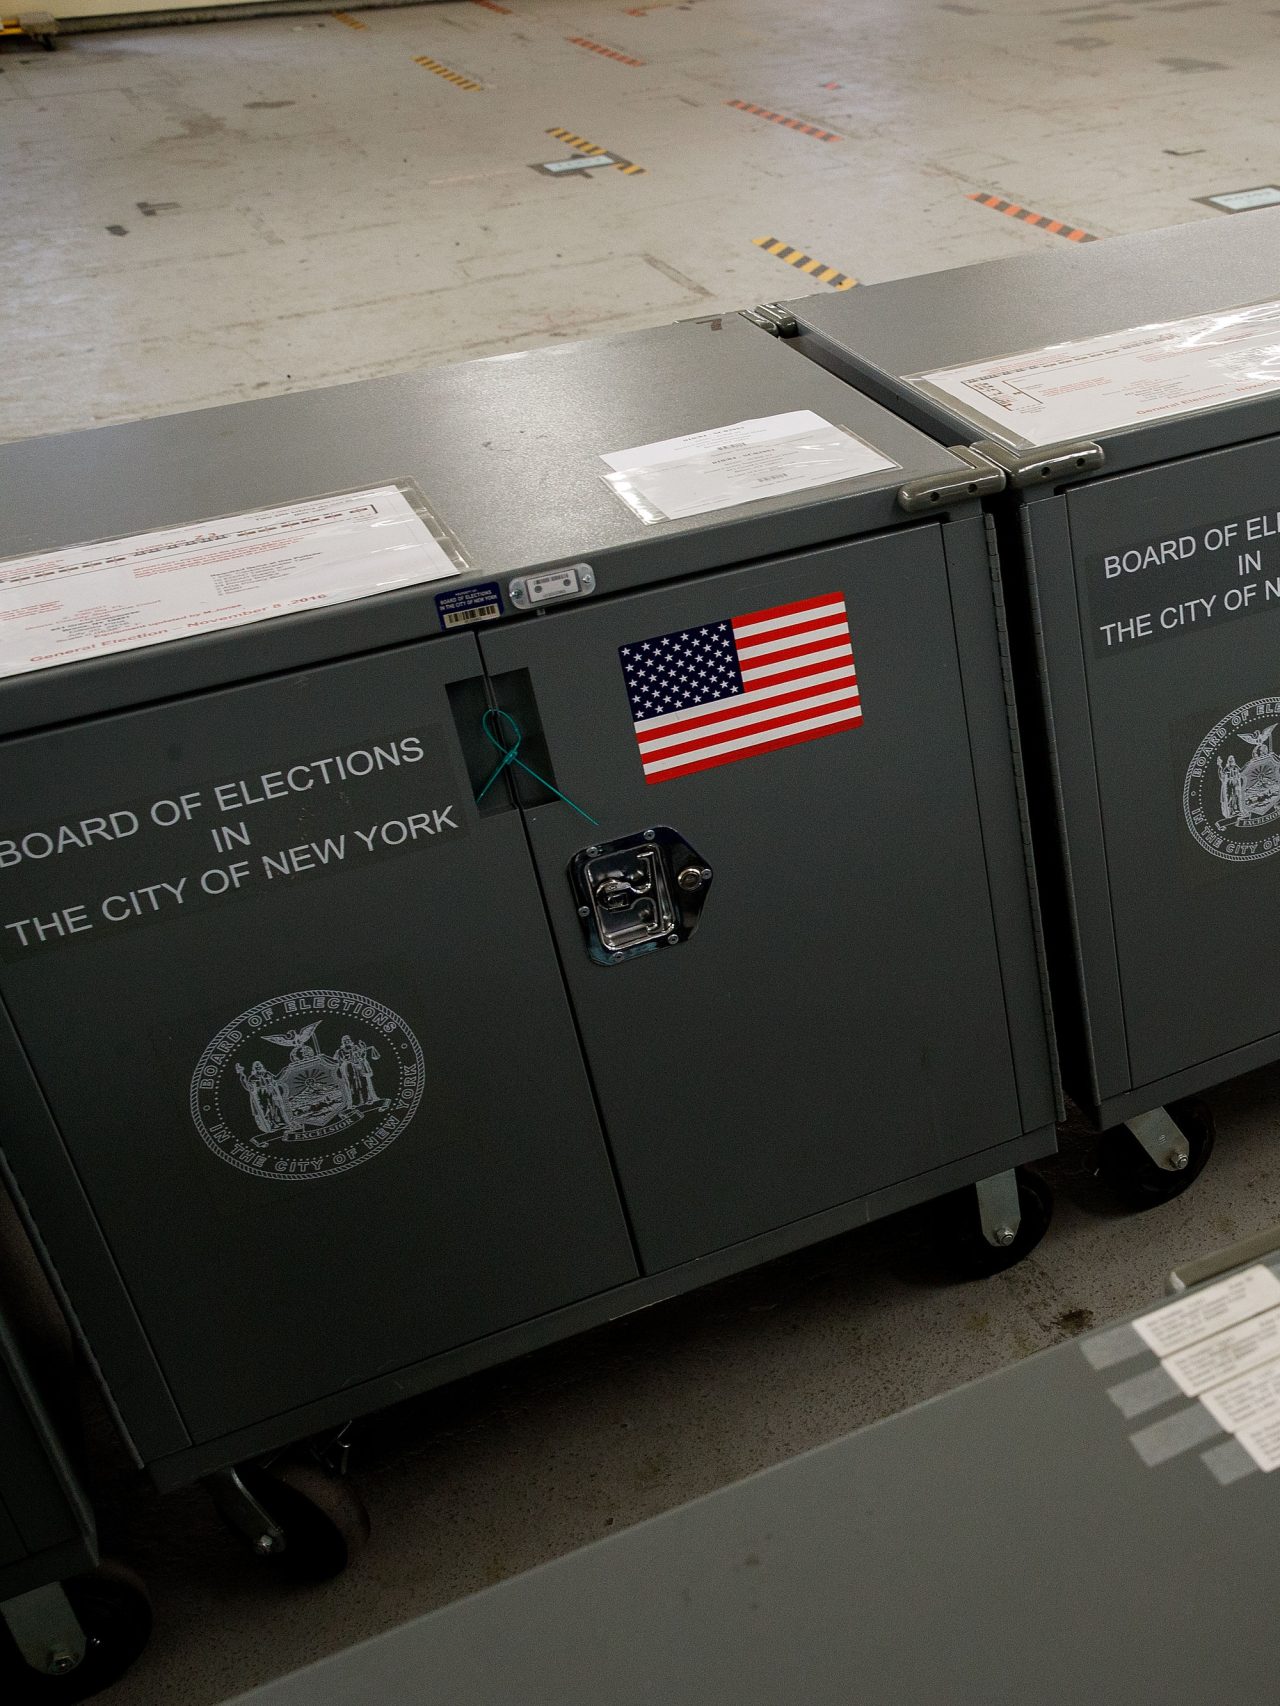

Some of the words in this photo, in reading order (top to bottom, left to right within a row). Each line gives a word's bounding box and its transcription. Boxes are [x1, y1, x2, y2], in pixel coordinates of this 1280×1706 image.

[1136, 402, 1180, 416] General
[1104, 535, 1197, 579] BOARD
[1204, 524, 1238, 551] OF
[1238, 551, 1262, 576] IN
[30, 643, 96, 662] General
[101, 629, 169, 647] Election
[187, 606, 269, 628] November
[1100, 613, 1153, 646] THE
[1160, 595, 1216, 629] CITY
[1224, 584, 1257, 611] OF
[1191, 727, 1228, 778] BOARD
[1231, 709, 1250, 726] OF
[0, 809, 139, 869] BOARD
[150, 792, 202, 827] OF
[214, 737, 425, 812] ELECTIONS
[211, 822, 251, 853] IN
[1200, 826, 1224, 849] THE
[1226, 843, 1259, 855] CITY
[5, 905, 93, 946] THE
[101, 877, 188, 922] CITY
[200, 861, 250, 895] OF
[262, 834, 346, 880] NEW
[353, 805, 459, 852] YORK
[201, 1030, 243, 1090] BOARD
[248, 1009, 275, 1028] OF
[284, 996, 397, 1034] ELECTIONS
[209, 1123, 231, 1144] IN
[230, 1143, 268, 1168] THE
[274, 1159, 324, 1173] CITY
[332, 1147, 359, 1166] OF
[363, 1115, 401, 1149] NEW
[395, 1063, 418, 1111] YORK
[294, 1118, 354, 1141] EXCELSIOR
